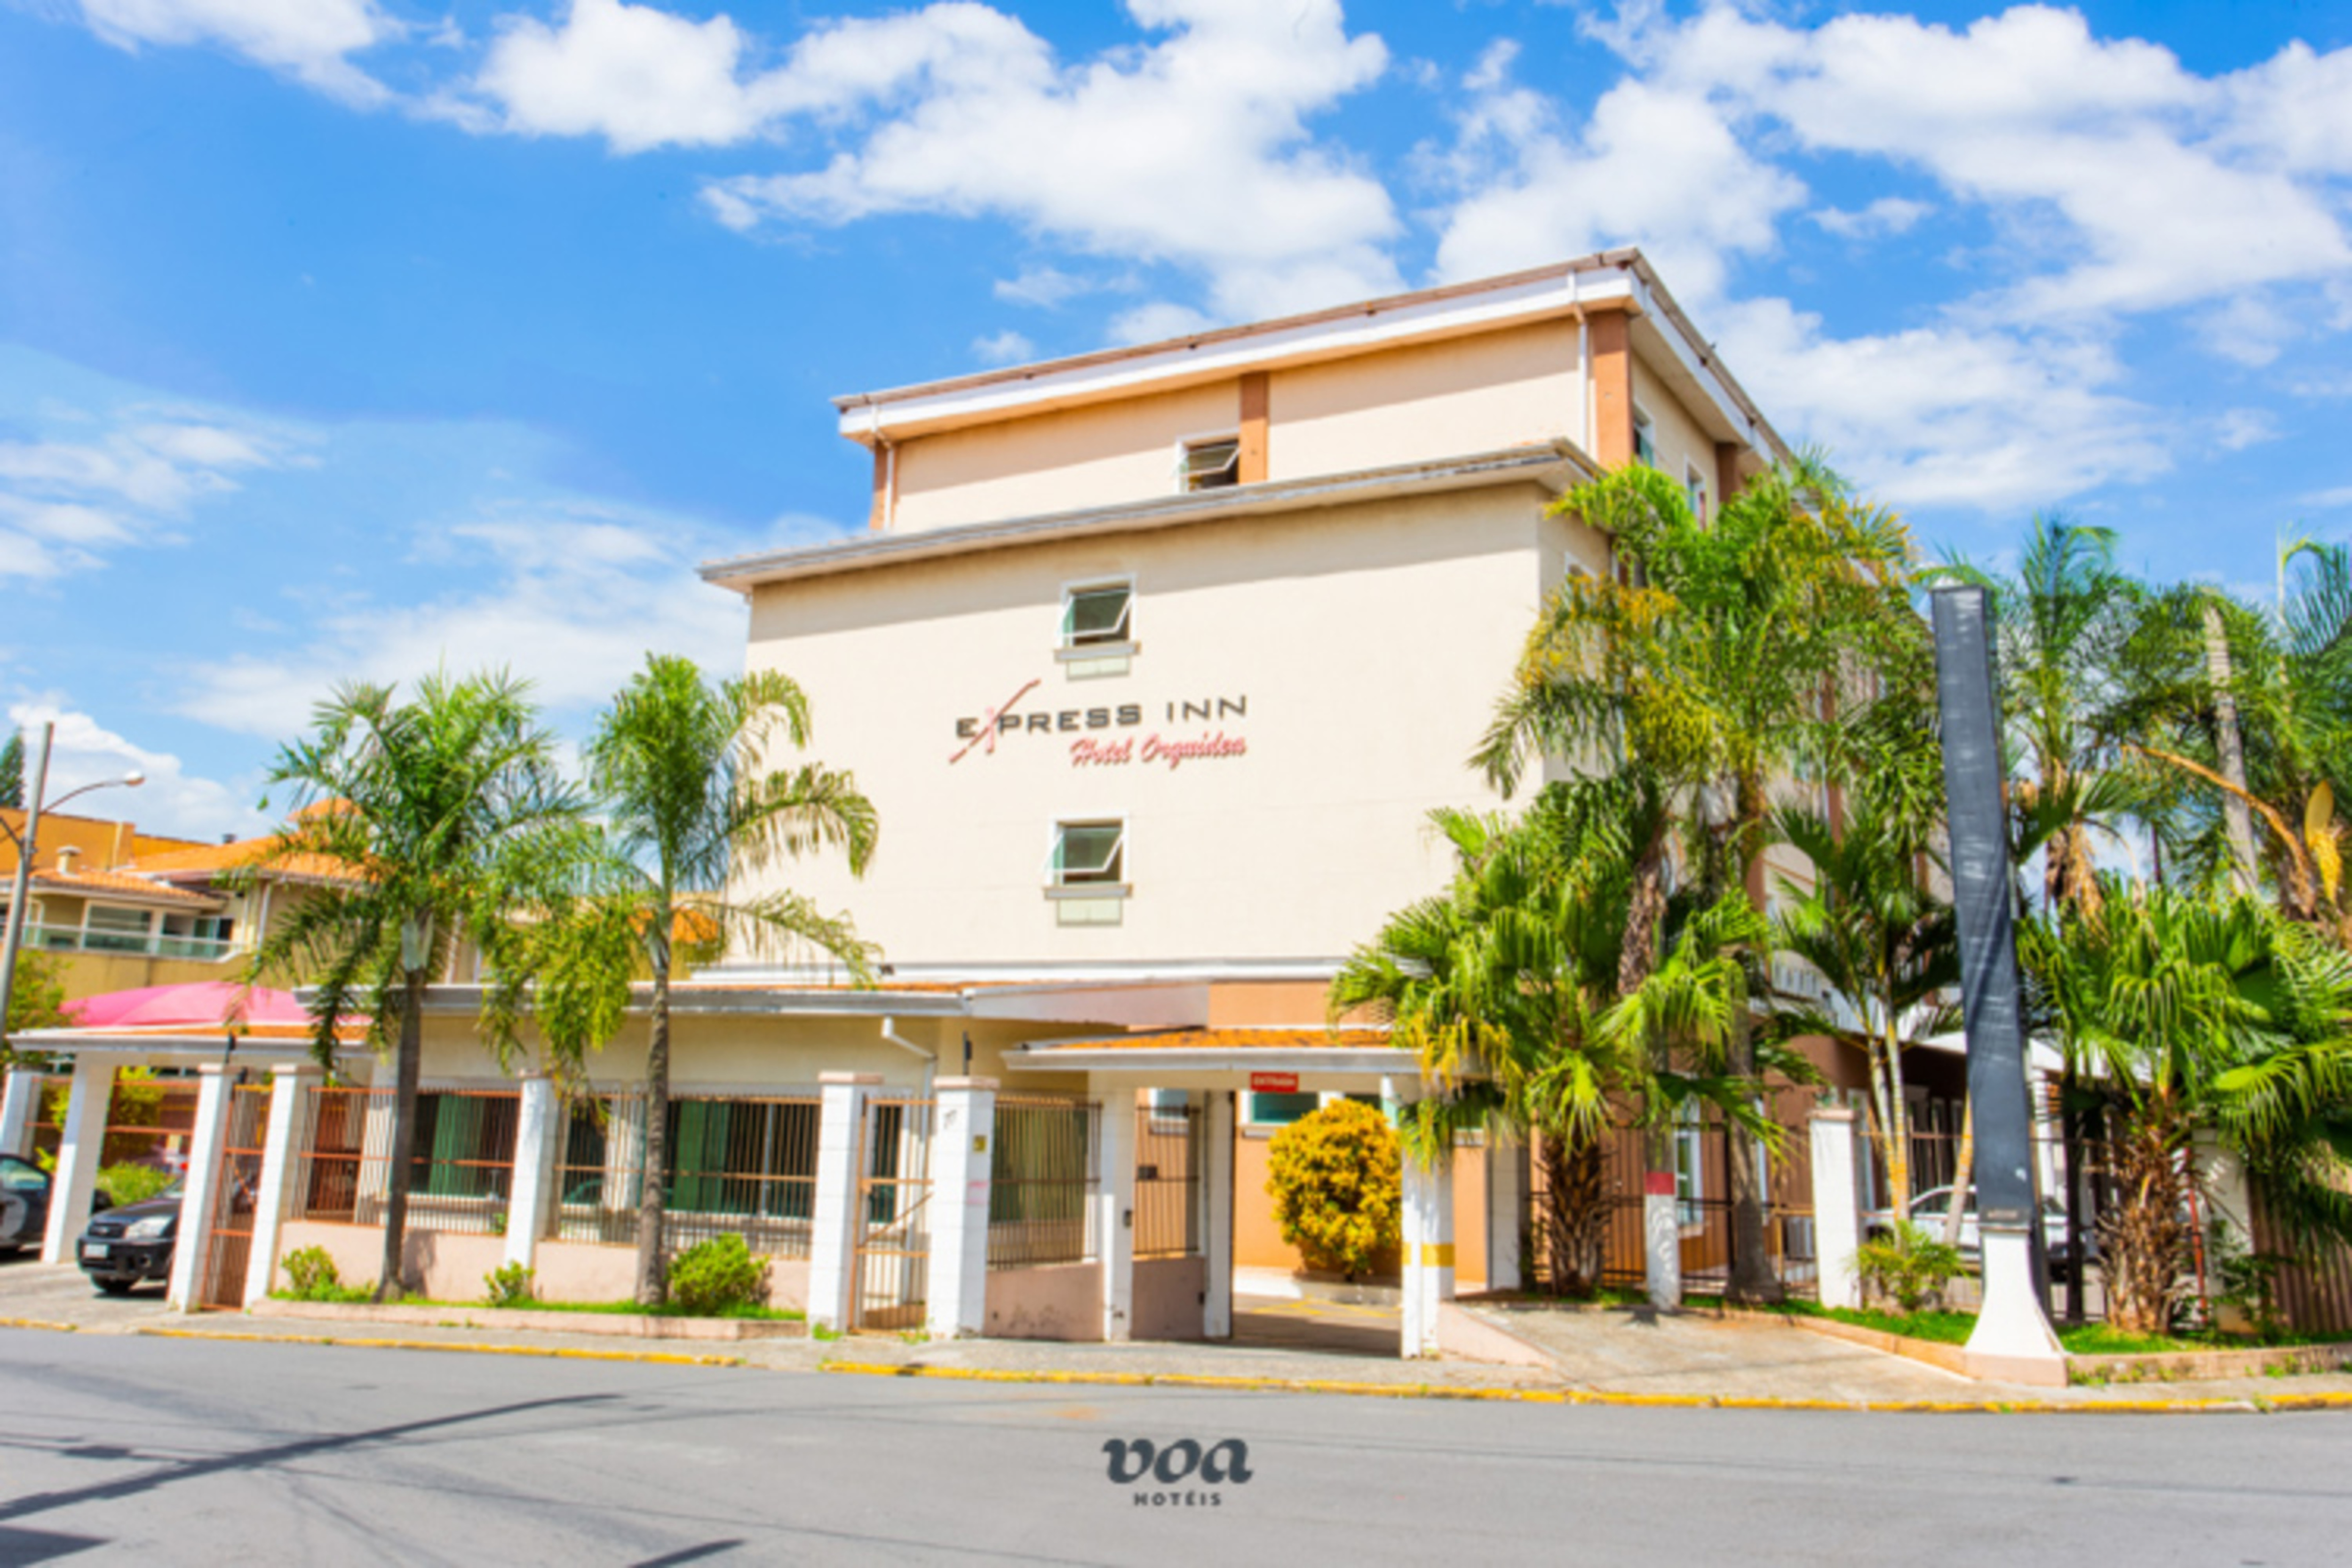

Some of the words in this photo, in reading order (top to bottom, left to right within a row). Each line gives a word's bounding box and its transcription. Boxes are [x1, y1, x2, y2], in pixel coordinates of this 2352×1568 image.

[949, 678, 1142, 764] EXPRESS
[1167, 694, 1247, 723] INN
[1069, 737, 1134, 767] Hotel
